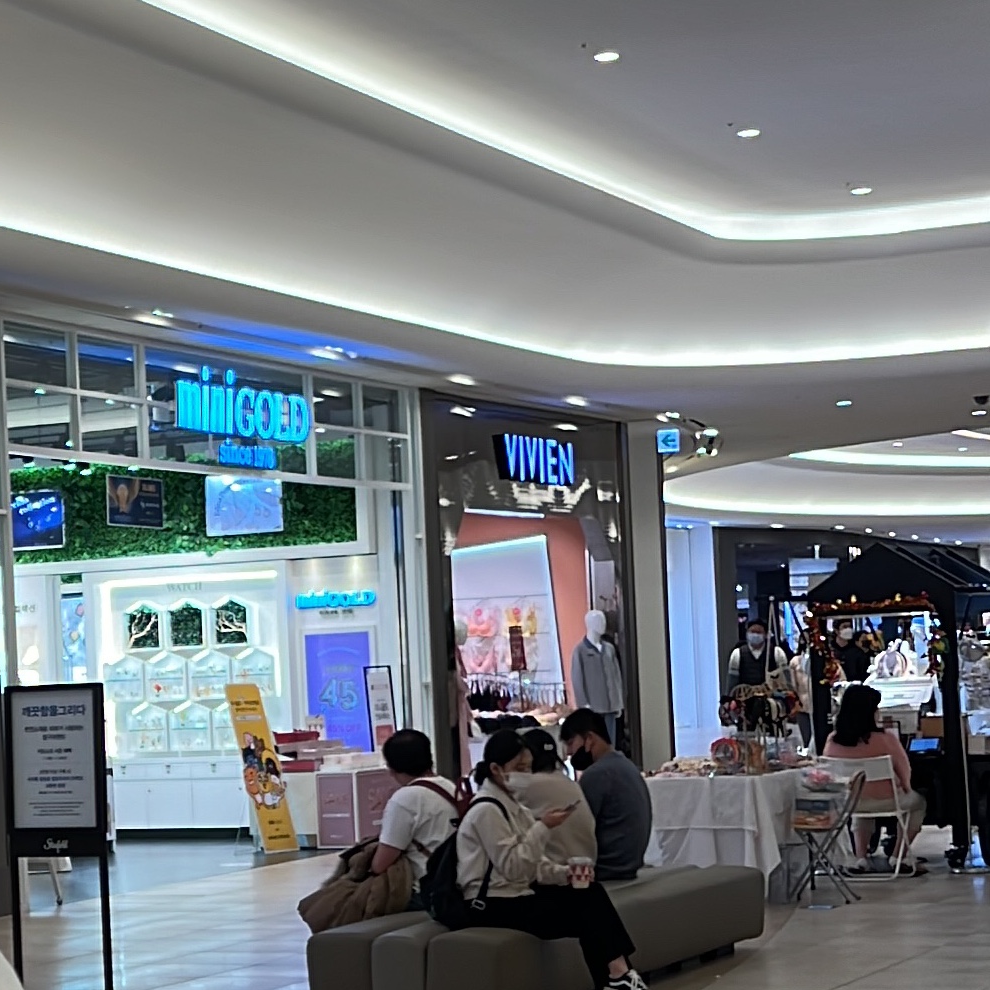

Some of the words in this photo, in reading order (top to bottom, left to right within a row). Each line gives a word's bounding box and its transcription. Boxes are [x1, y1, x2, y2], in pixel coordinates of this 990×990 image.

[176, 365, 310, 443] miniGOLD
[504, 433, 574, 486] VIVIEN
[166, 581, 202, 593] WATCH
